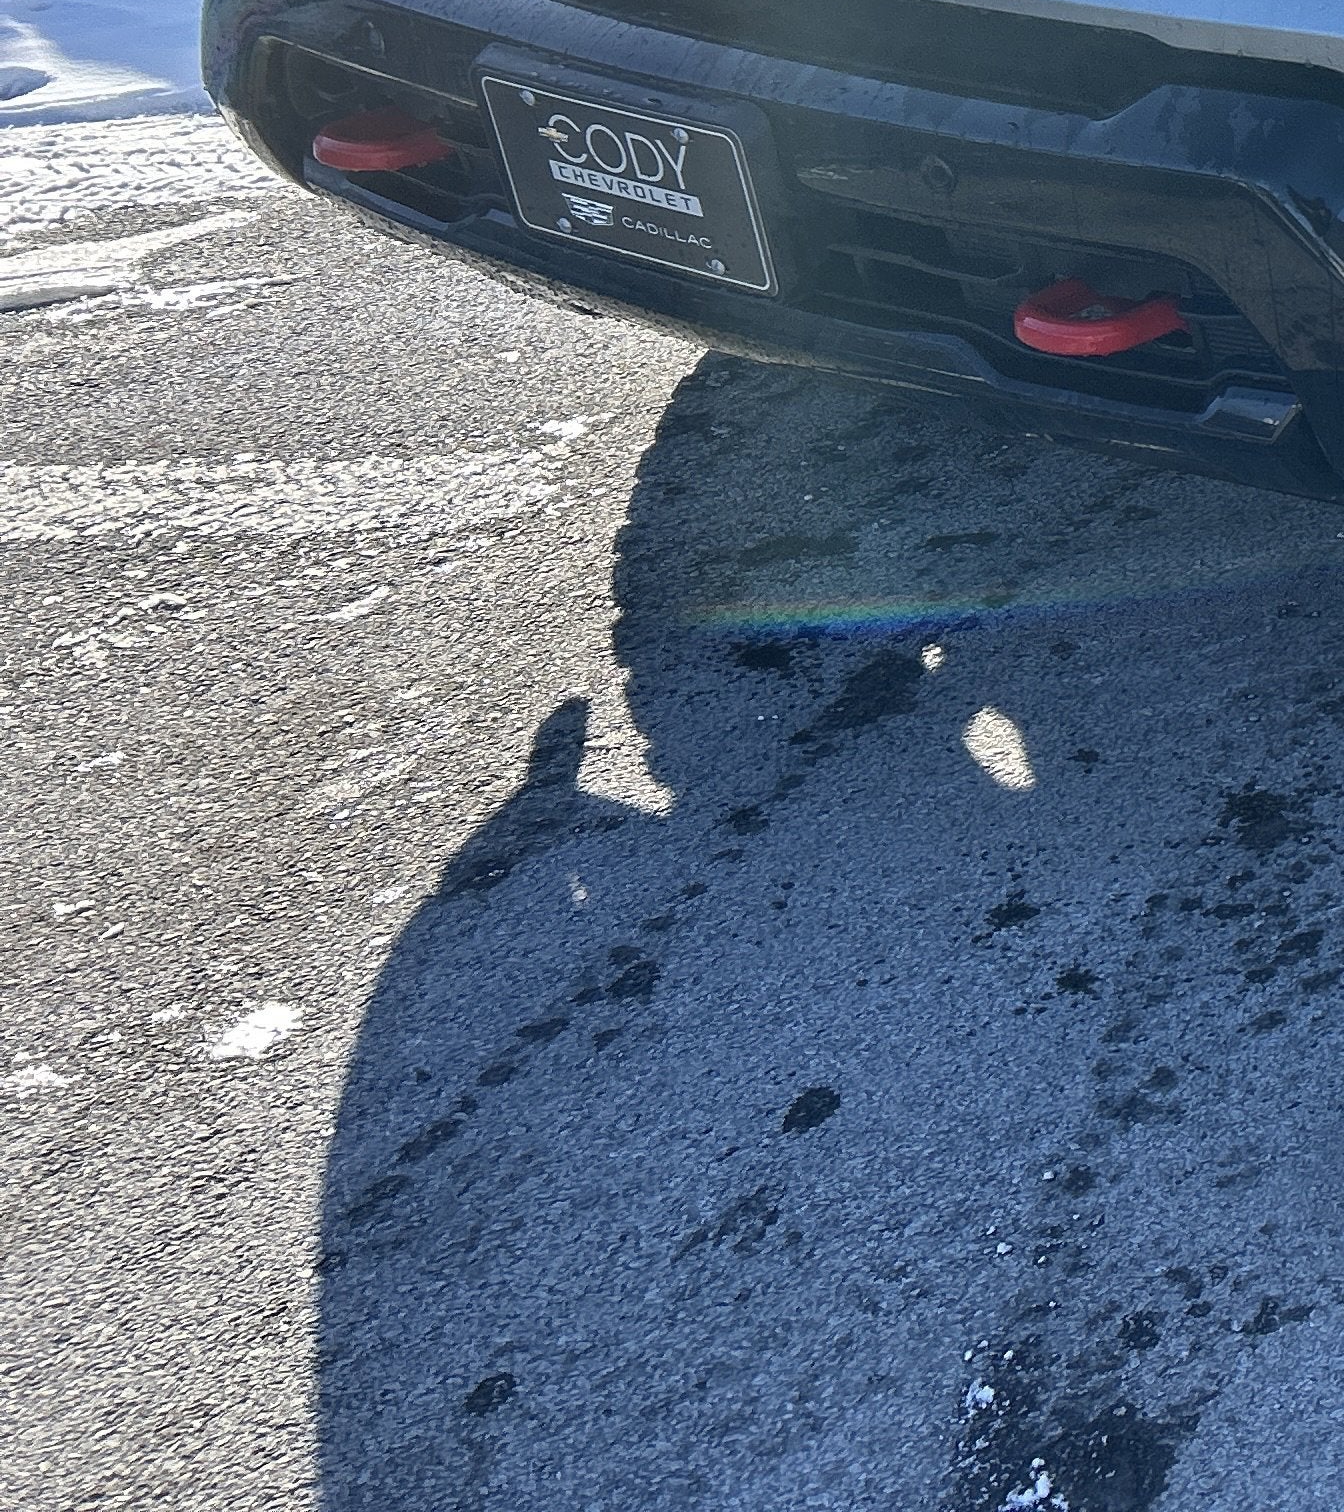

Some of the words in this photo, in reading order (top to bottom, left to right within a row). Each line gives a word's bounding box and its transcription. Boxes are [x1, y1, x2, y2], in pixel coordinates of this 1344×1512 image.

[547, 113, 687, 191] CODY
[556, 164, 696, 213] CHEVROLET
[620, 215, 713, 250] CADILLAC
